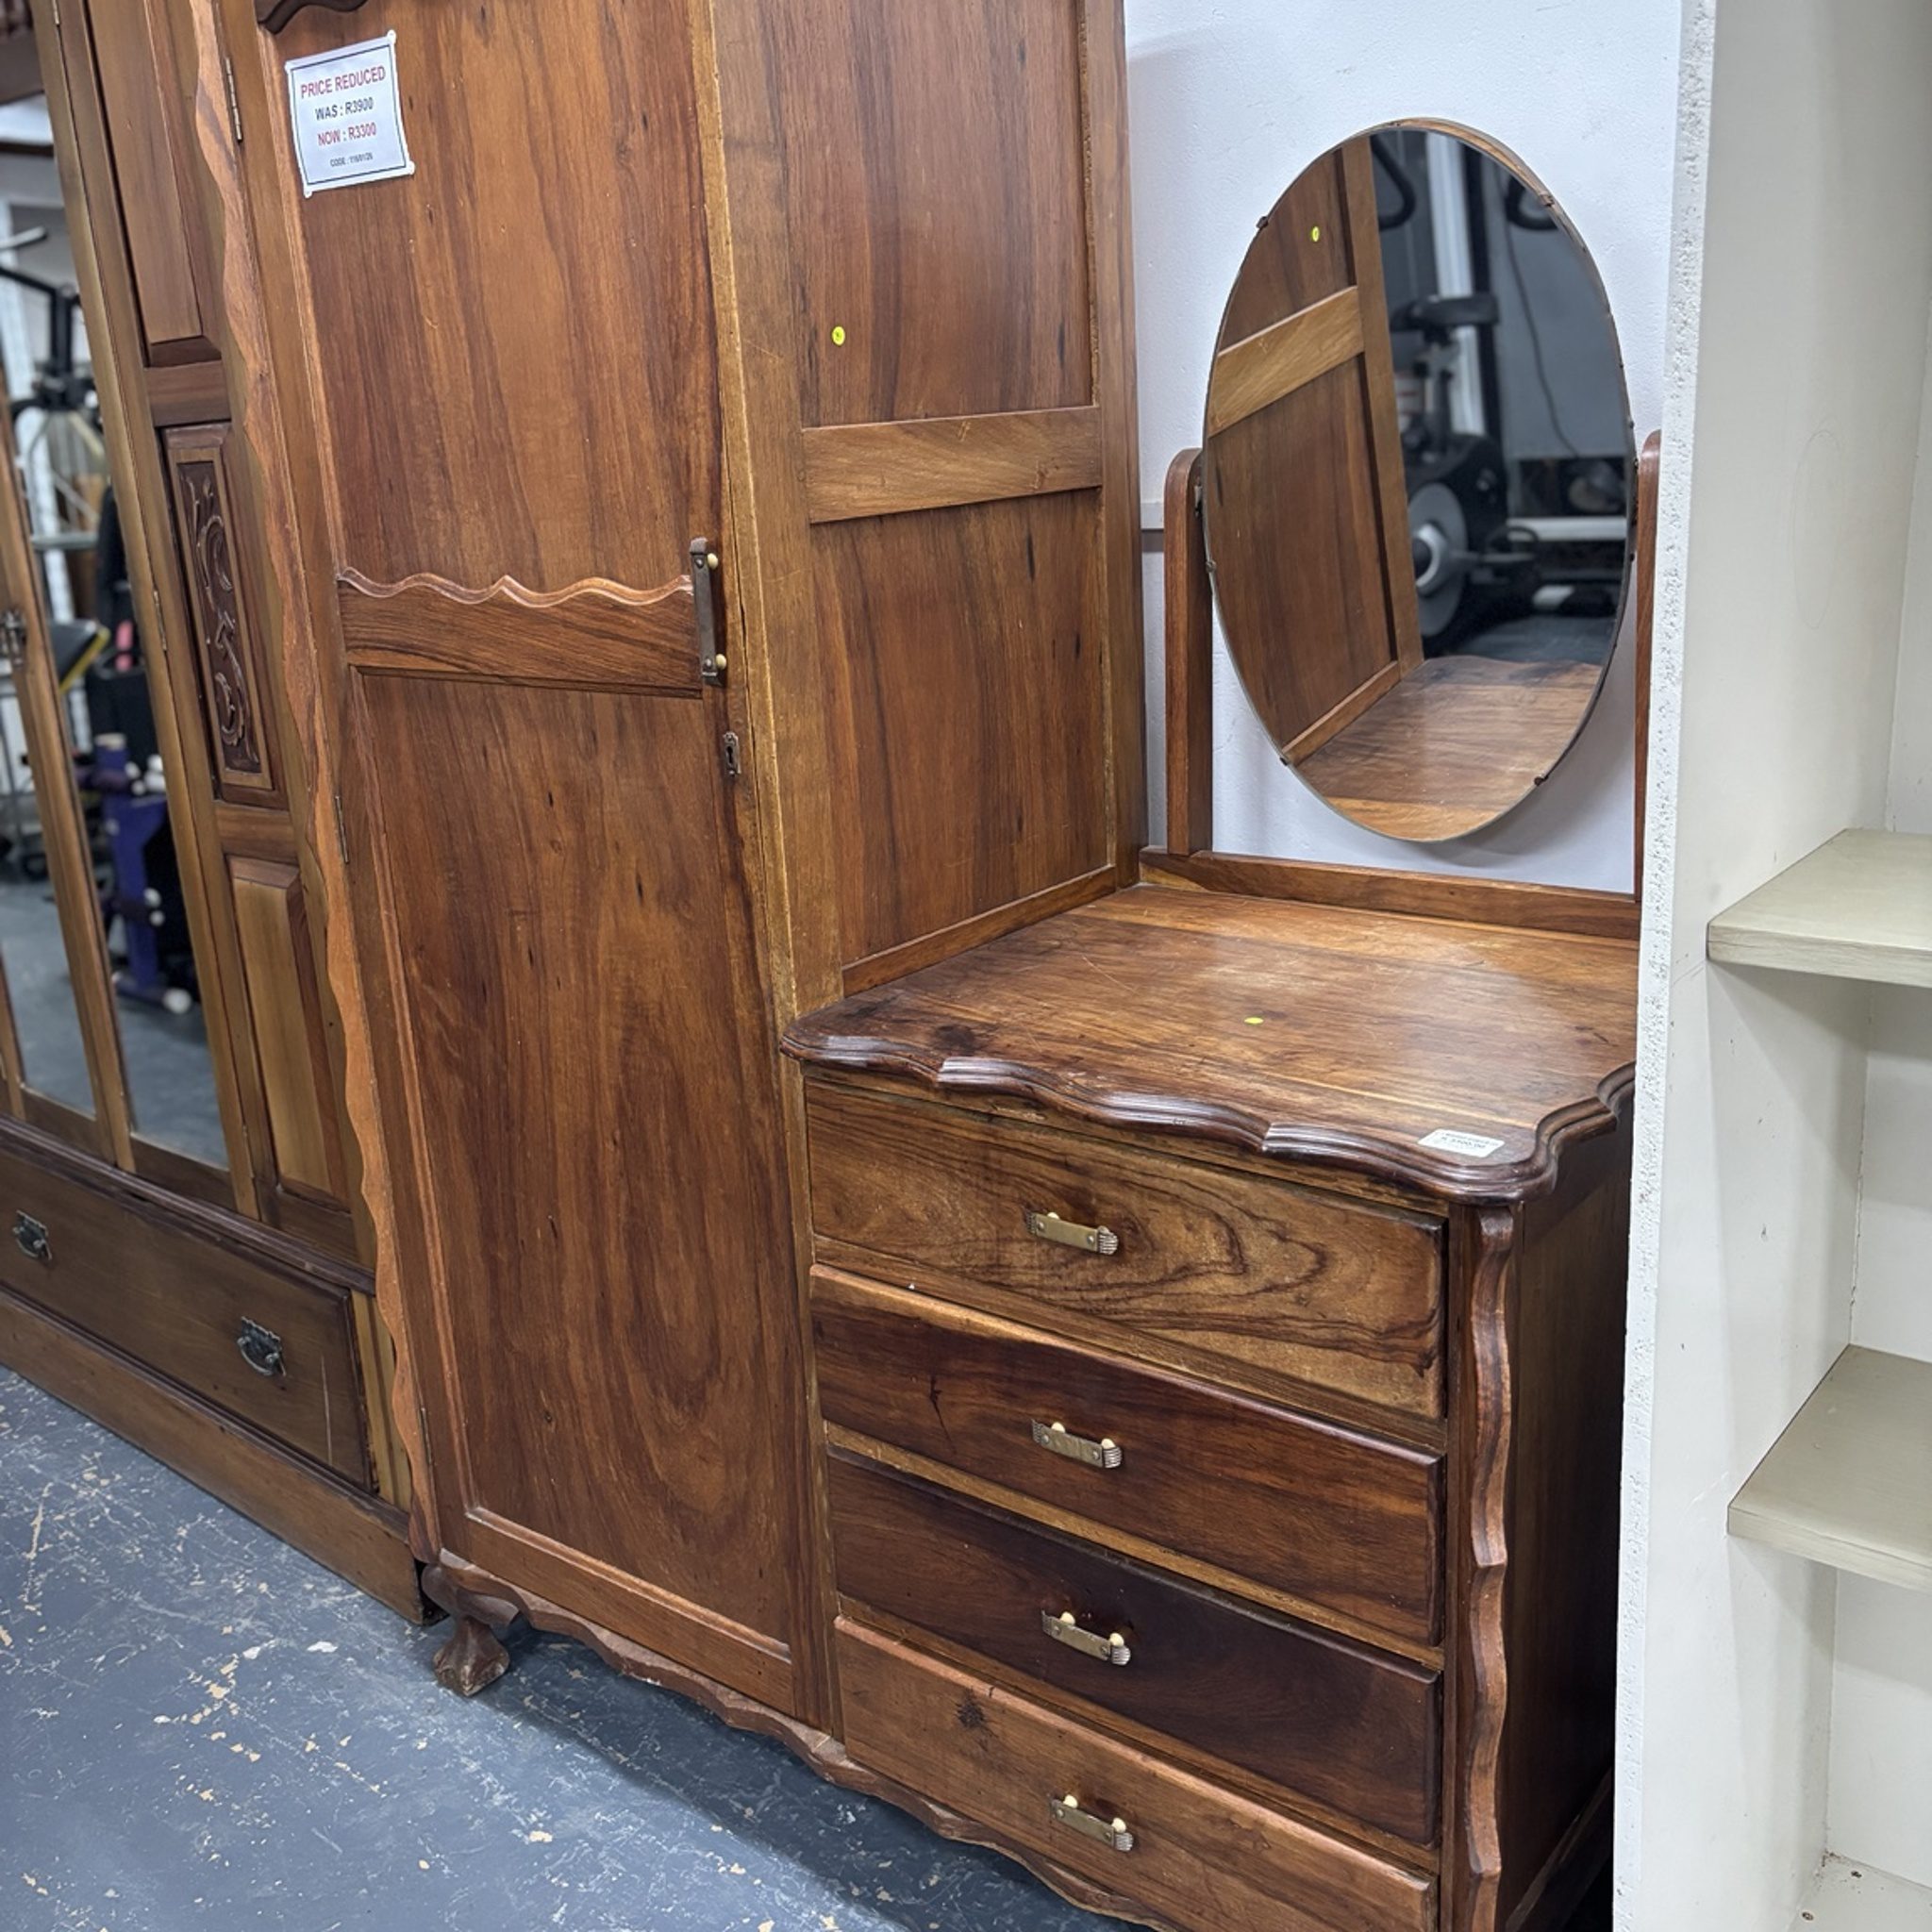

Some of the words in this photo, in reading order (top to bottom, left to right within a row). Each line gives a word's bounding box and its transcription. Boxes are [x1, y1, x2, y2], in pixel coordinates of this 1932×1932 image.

[301, 78, 333, 99] PRICE
[335, 65, 386, 92] REDUCED
[315, 104, 339, 121] WAS
[345, 97, 375, 114] R3900
[317, 130, 341, 146] NOW
[348, 122, 376, 141] R3300
[330, 157, 346, 167] CODE
